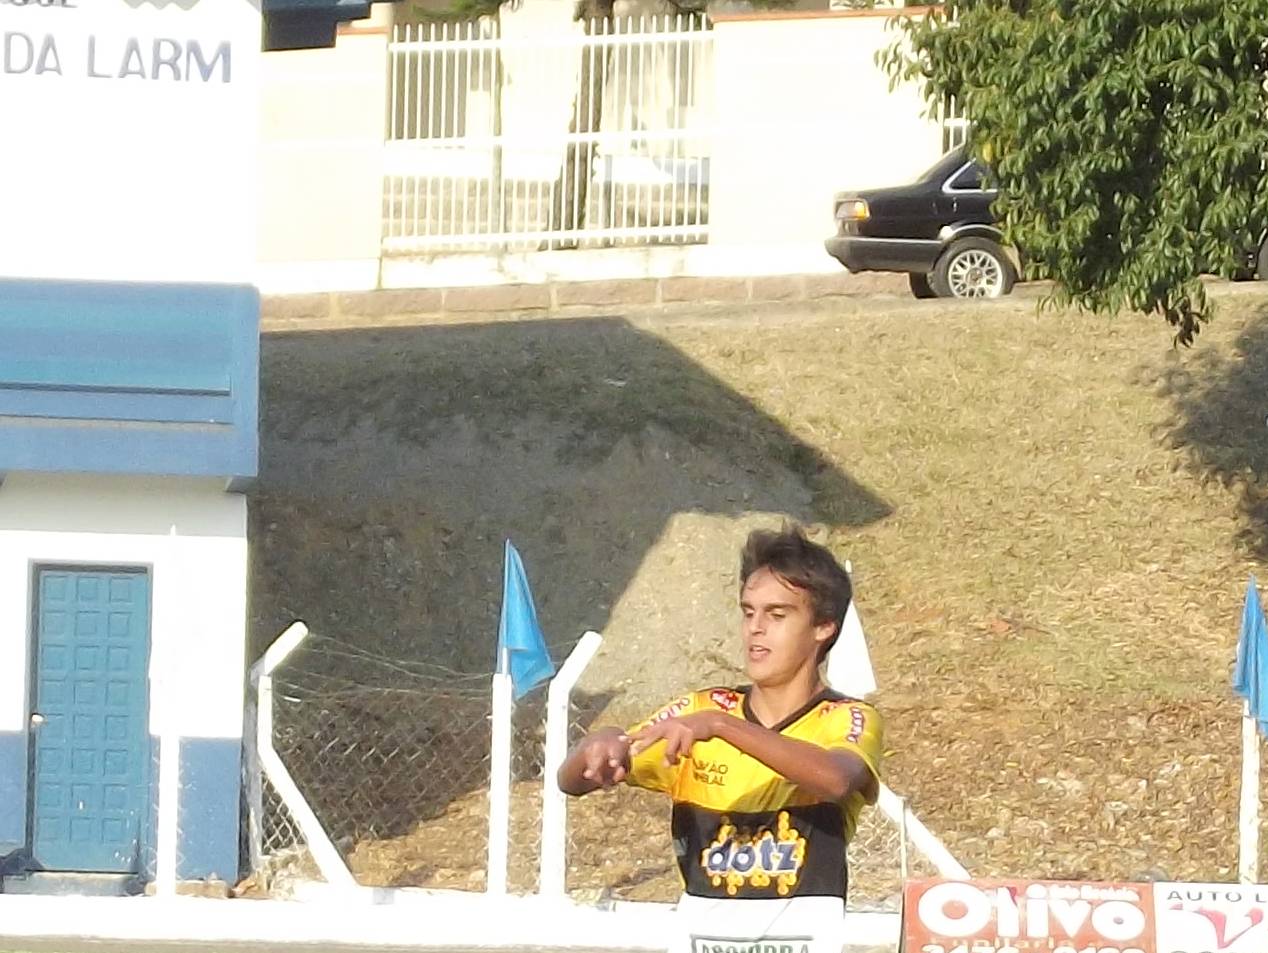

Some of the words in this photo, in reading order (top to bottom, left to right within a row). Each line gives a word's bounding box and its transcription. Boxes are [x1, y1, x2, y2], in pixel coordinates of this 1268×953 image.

[3, 31, 63, 76] DA
[87, 33, 232, 84] LARM
[707, 837, 799, 873] dotz
[1166, 889, 1243, 903] AUTO
